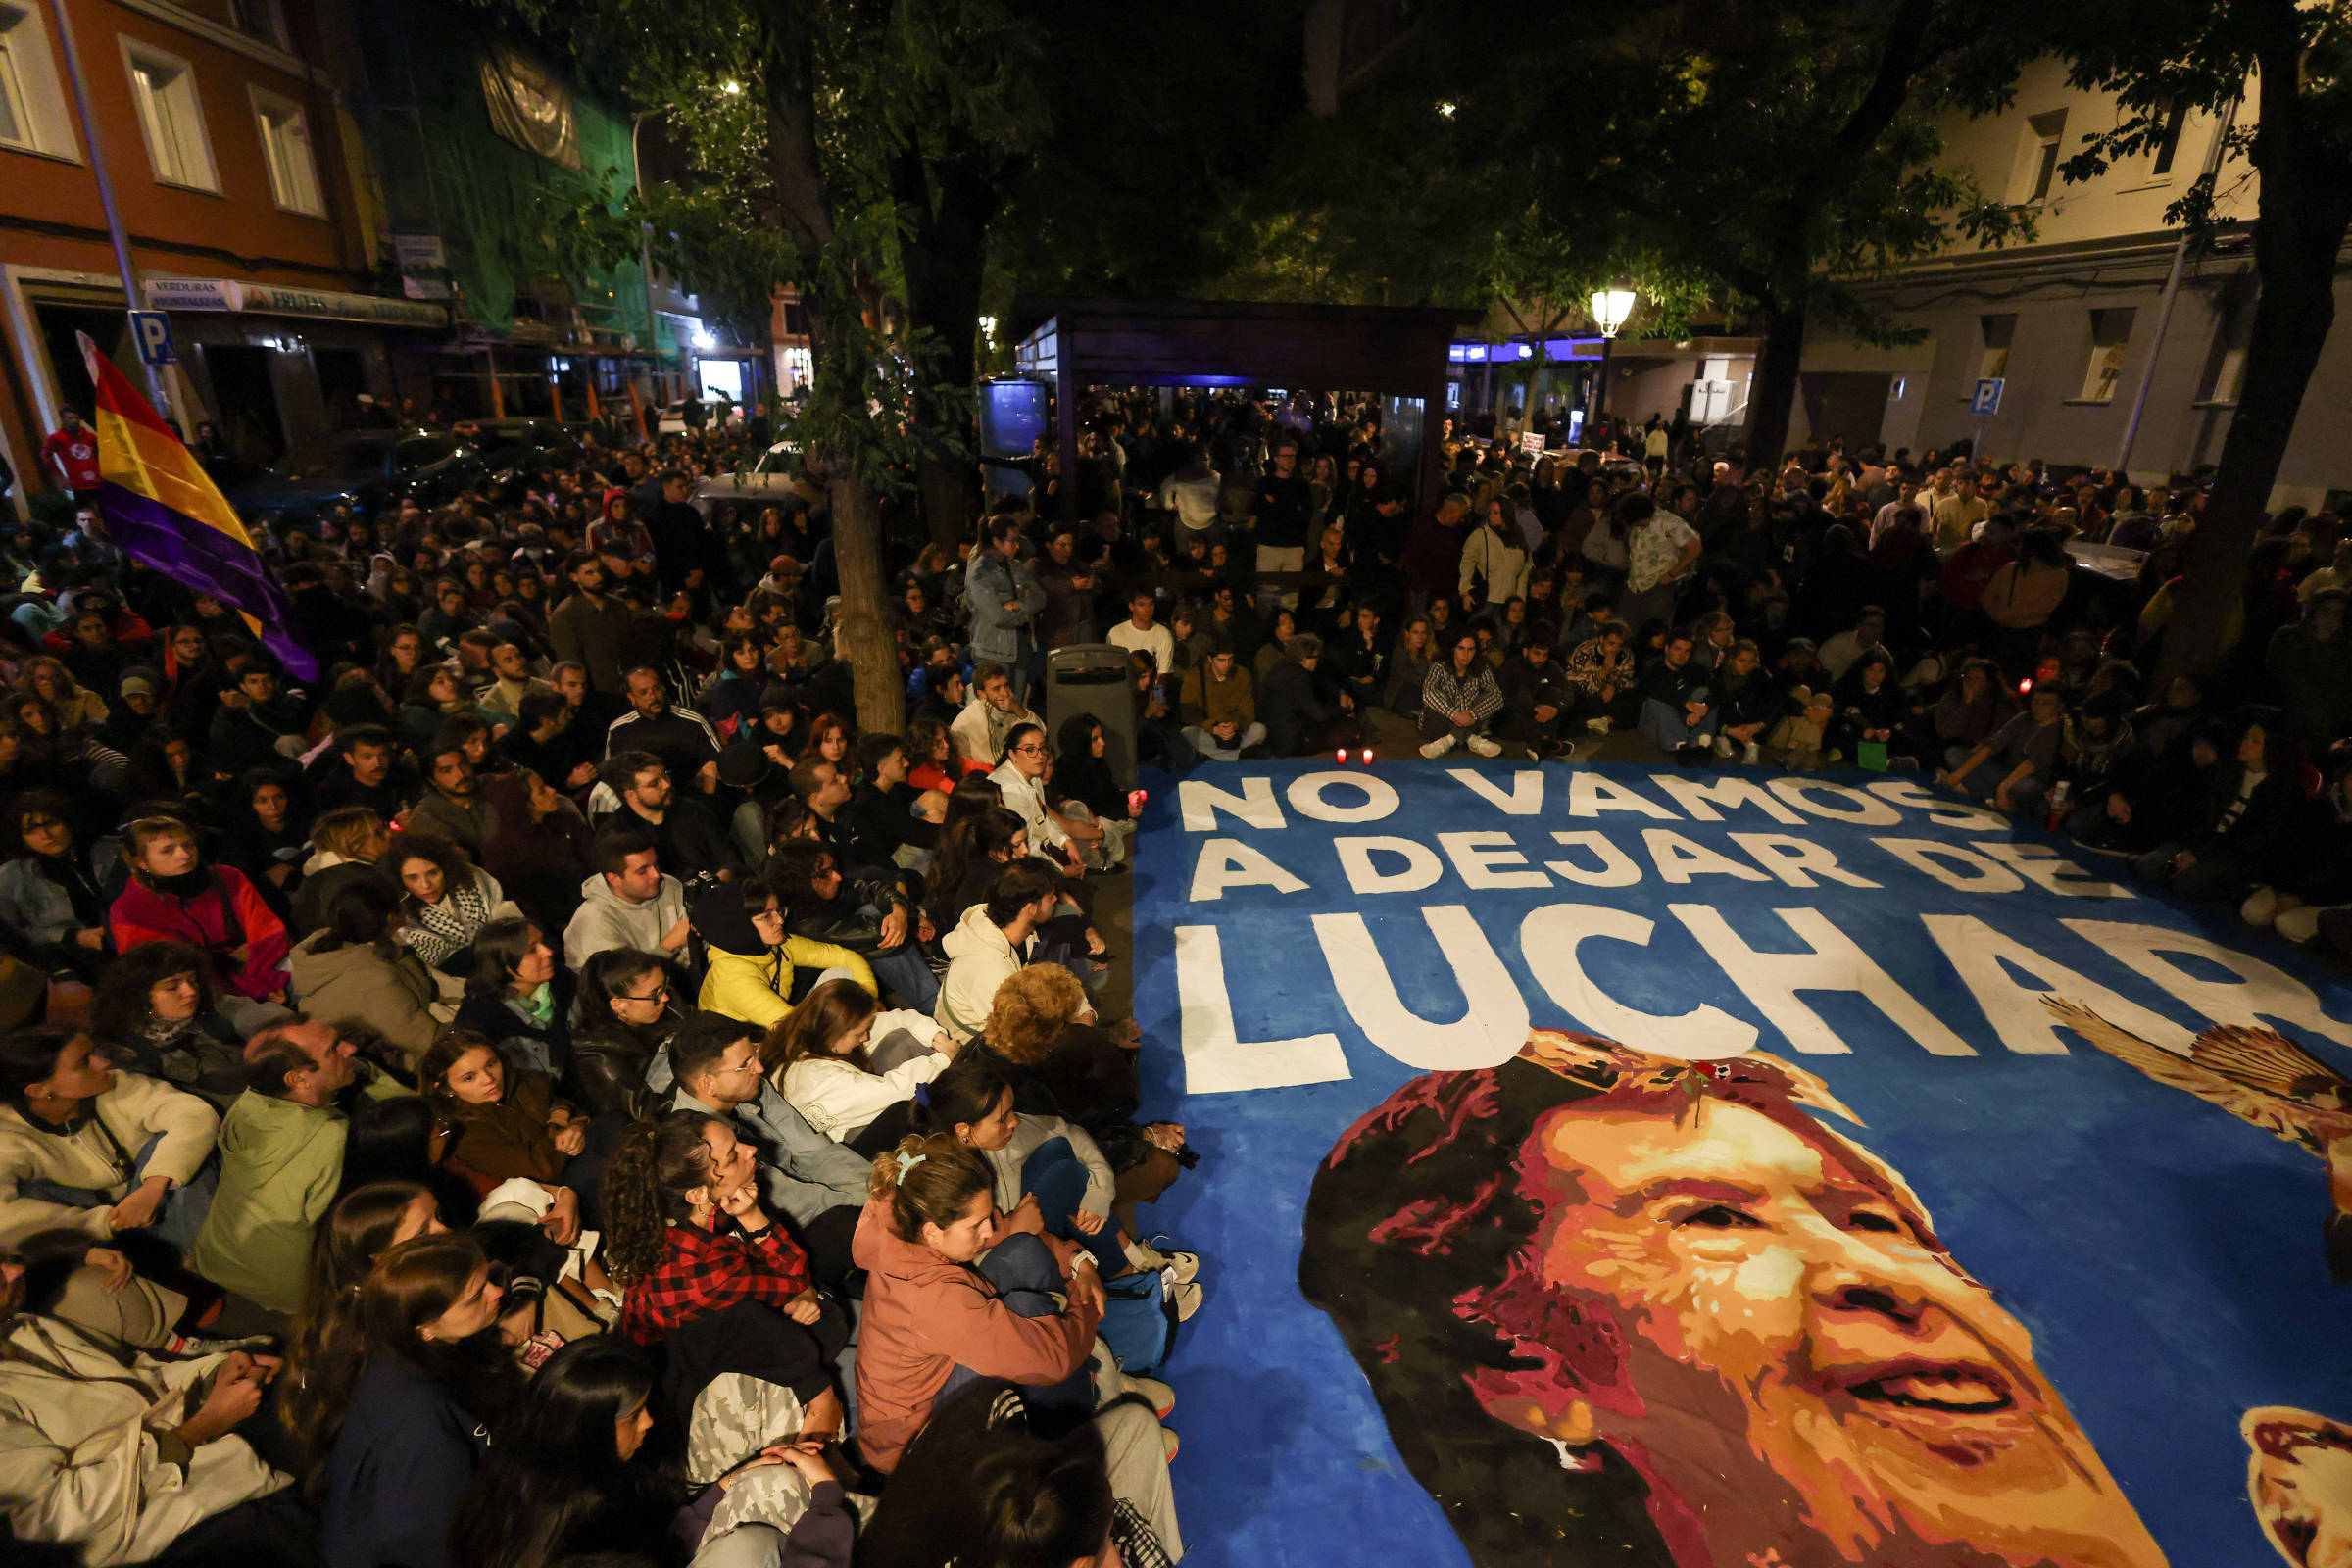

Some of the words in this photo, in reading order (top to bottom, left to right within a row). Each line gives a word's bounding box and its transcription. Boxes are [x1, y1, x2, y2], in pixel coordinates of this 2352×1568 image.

[155, 281, 216, 292] VERDURAS
[140, 318, 166, 359] P
[1976, 383, 1995, 411] P
[1179, 771, 1400, 832] NO
[1445, 768, 2012, 831] VAMOS
[1189, 838, 1310, 902] A
[1333, 828, 1885, 894] DEJAR
[1869, 837, 2137, 899] DE
[1174, 903, 2352, 1095] LUCHAR
